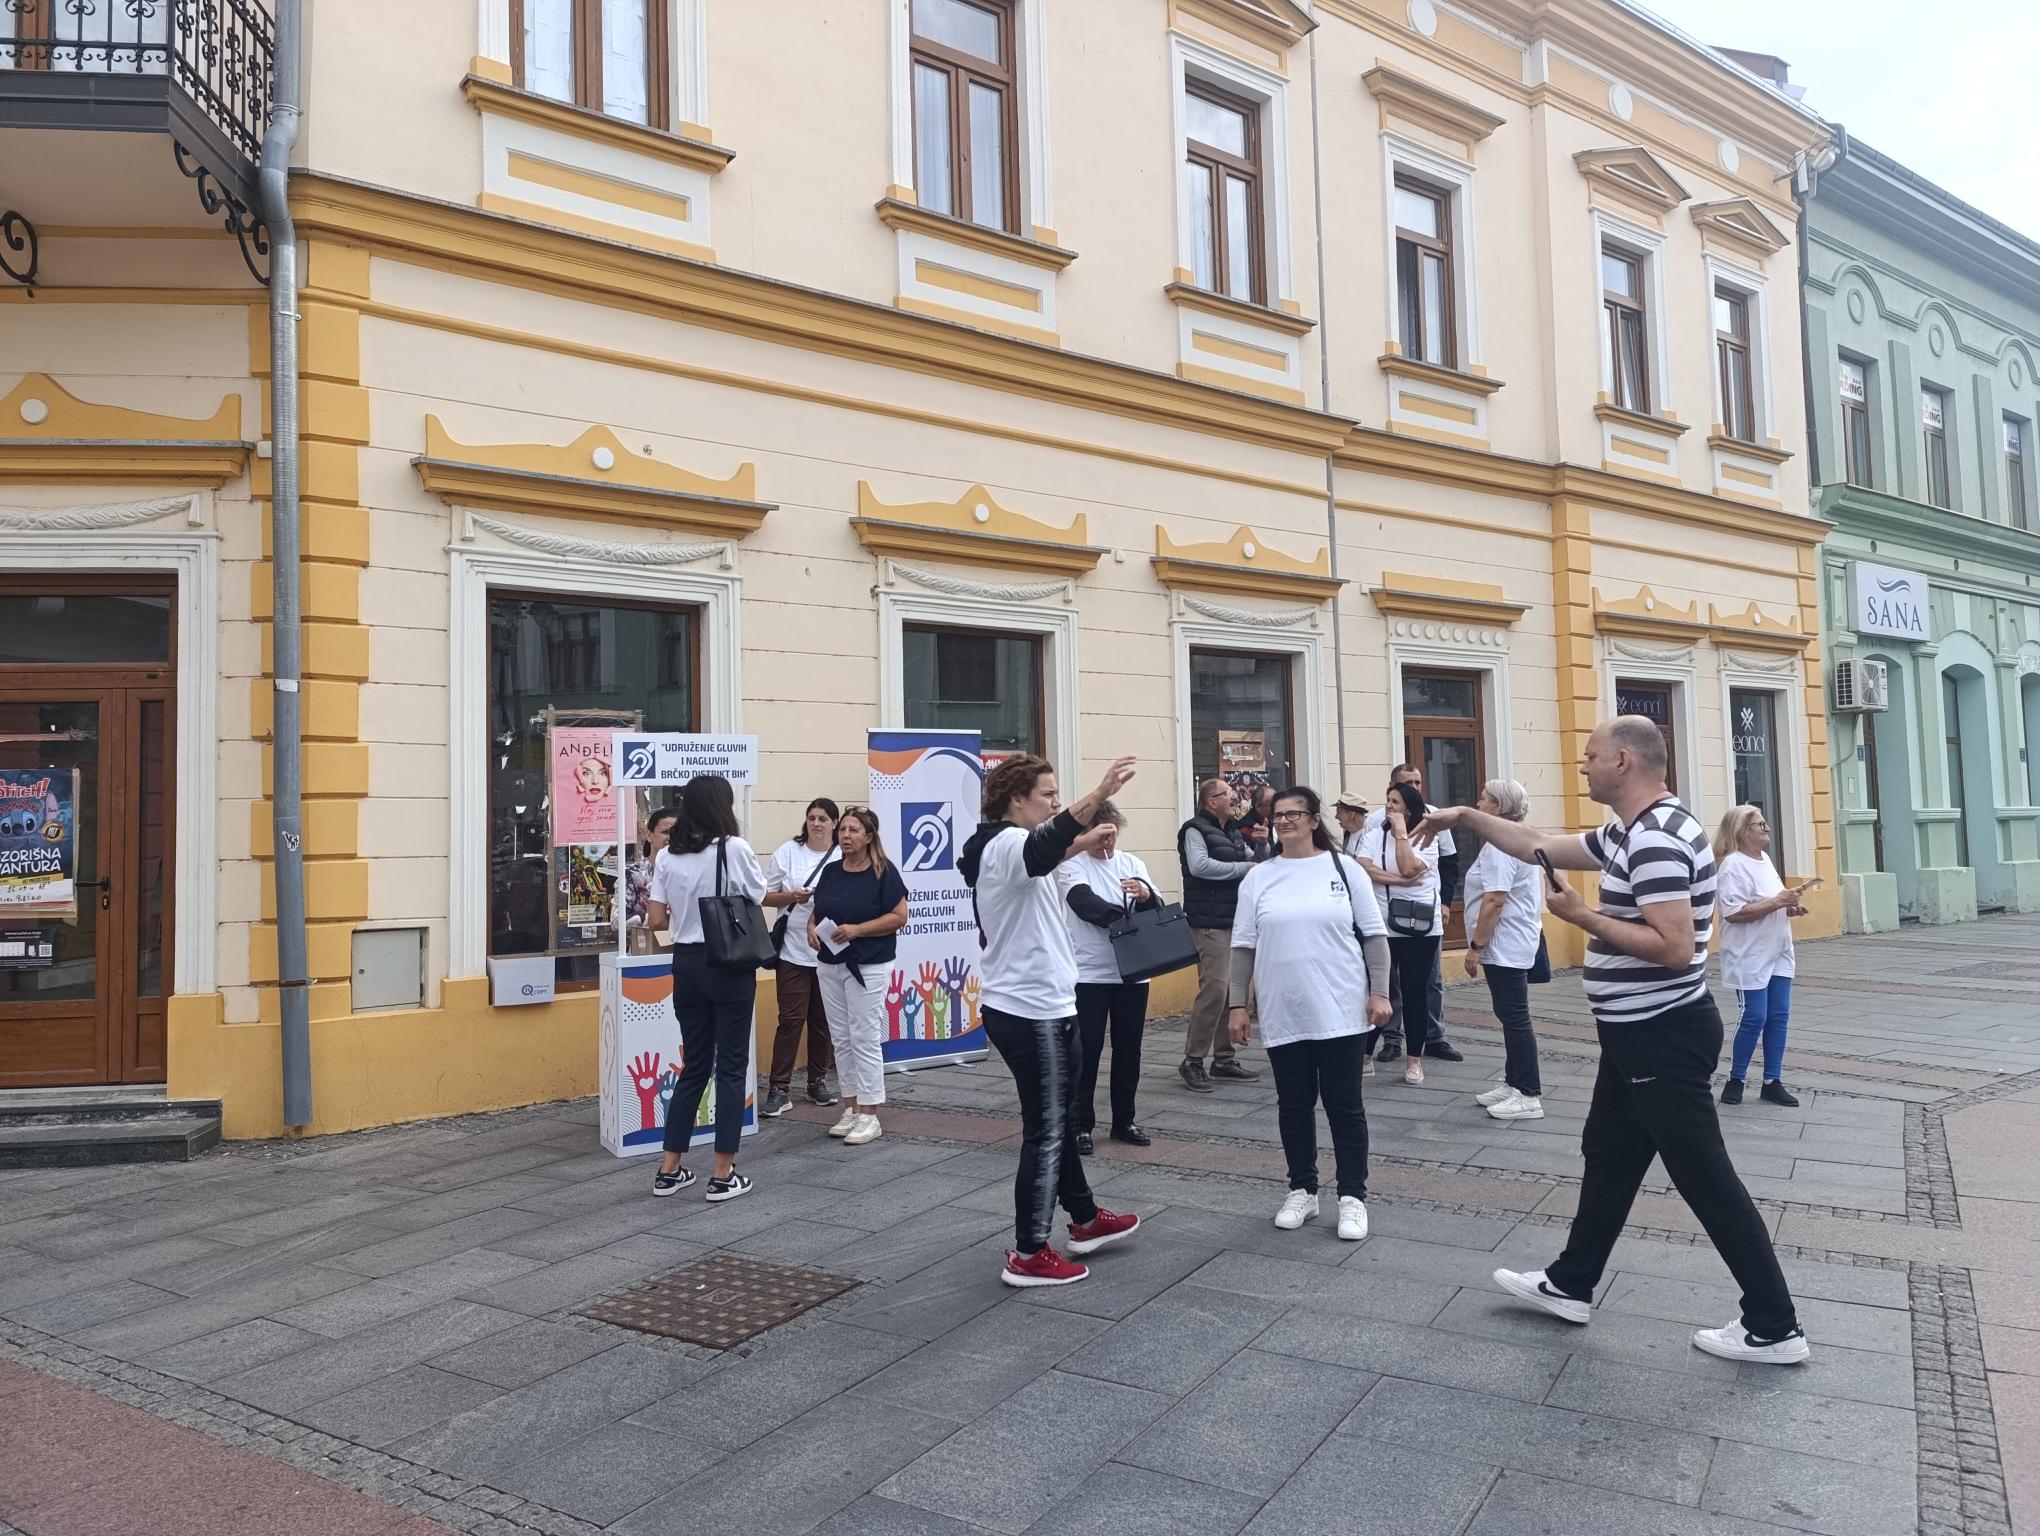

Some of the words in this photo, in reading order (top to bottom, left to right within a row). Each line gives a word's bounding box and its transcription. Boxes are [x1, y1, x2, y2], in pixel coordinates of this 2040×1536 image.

[1867, 596, 1923, 632] SANA
[661, 741, 715, 752] "UDRUŽENJE
[717, 743, 747, 752] GLUVIH
[681, 757, 684, 765] I
[686, 757, 729, 766] NAGLUVIH
[661, 768, 690, 779] BRČKO
[0, 847, 62, 862] ZORIŠNA
[907, 889, 939, 902] UŽENJE
[908, 906, 955, 919] NAGLUVIH
[913, 921, 956, 935] DISTRIKT
